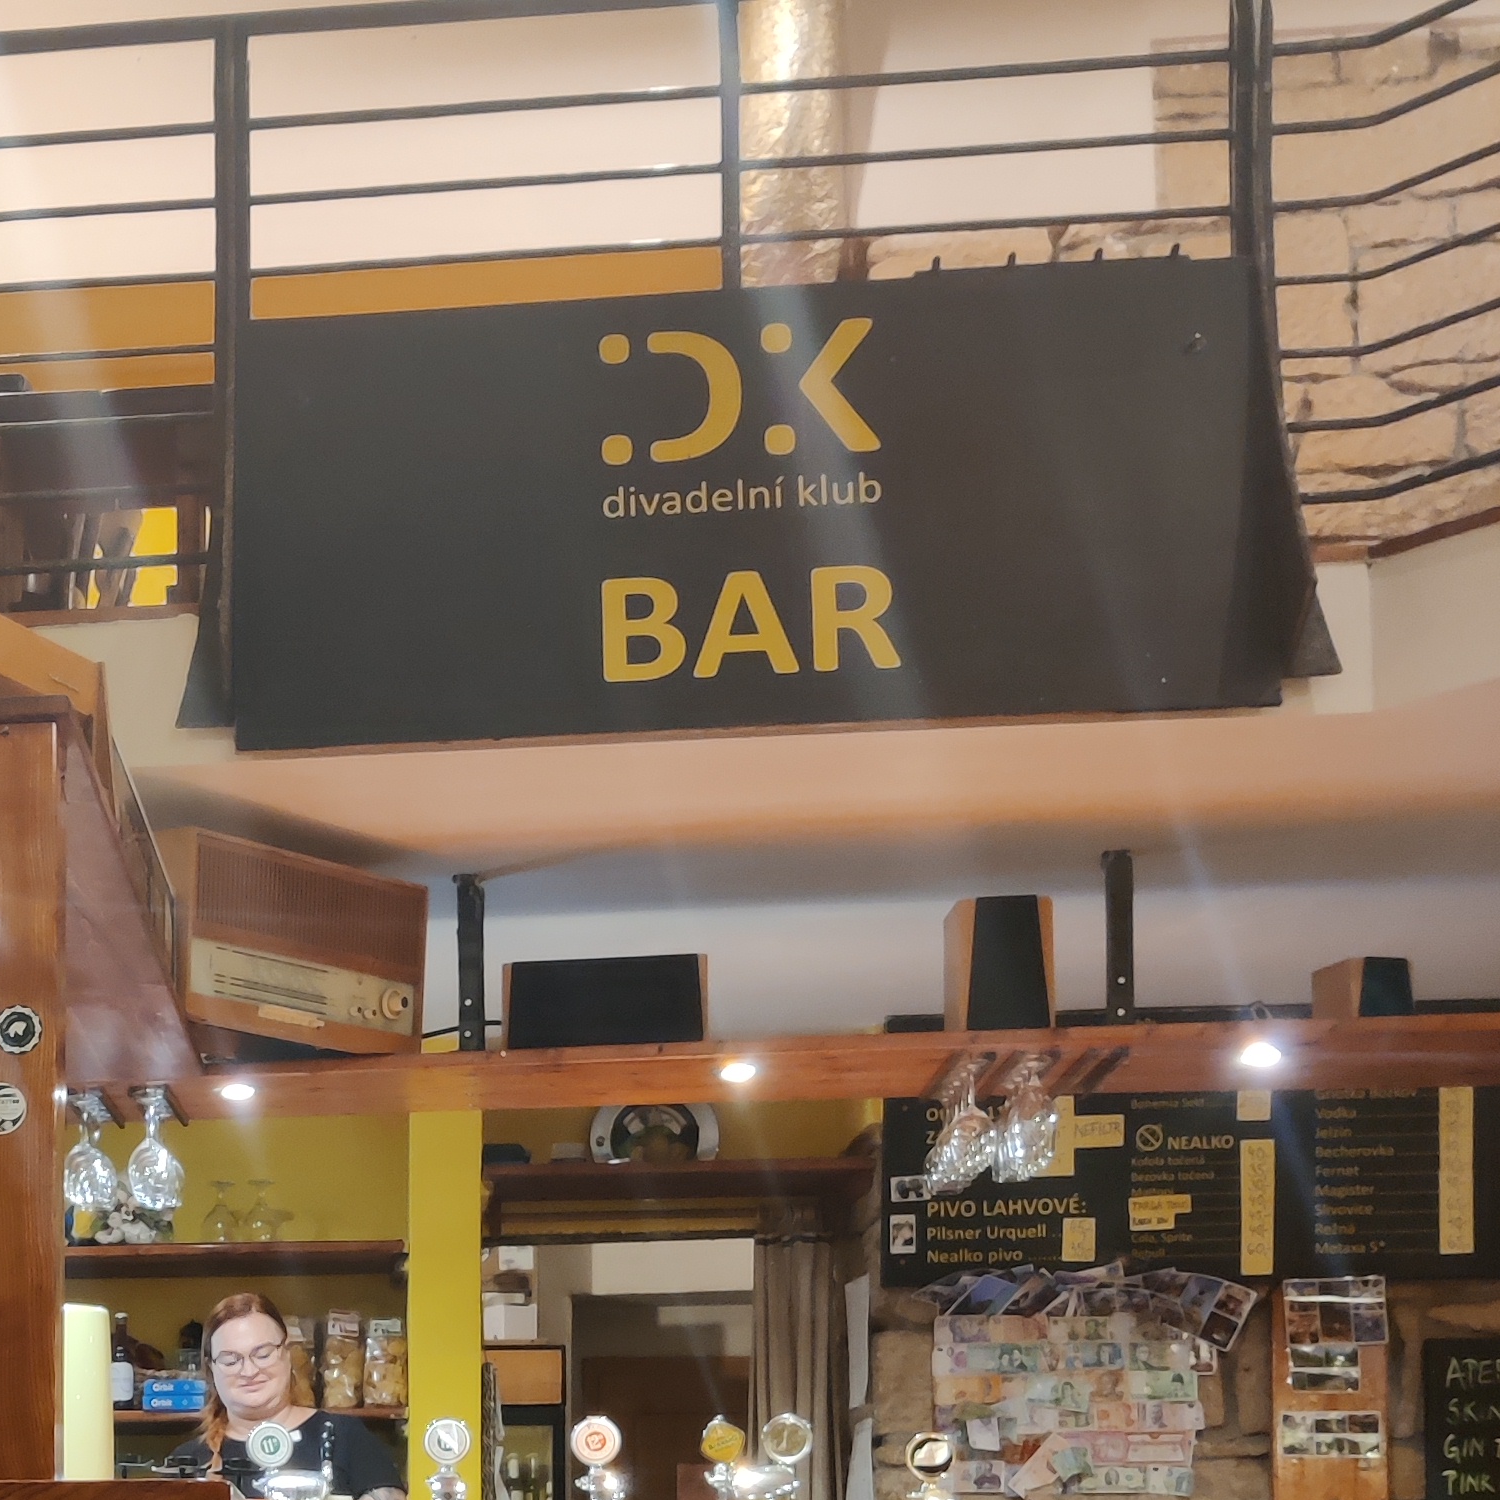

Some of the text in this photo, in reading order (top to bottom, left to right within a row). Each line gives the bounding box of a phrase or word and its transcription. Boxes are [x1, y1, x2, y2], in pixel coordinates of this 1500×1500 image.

[601, 471, 883, 519] divadelní klub
[600, 564, 902, 683] BAR
[1167, 1134, 1234, 1150] NEALKO
[927, 1193, 1087, 1217] PIVO LAHVOVÉ:
[927, 1227, 981, 1240] Pilsner
[987, 1224, 1047, 1242] Urquell
[927, 1247, 1023, 1266] Nealko pivo
[152, 1382, 174, 1392] Orbit
[150, 1398, 173, 1407] Orbit
[1443, 1433, 1485, 1464] GIN
[1441, 1469, 1496, 1496] PINK
